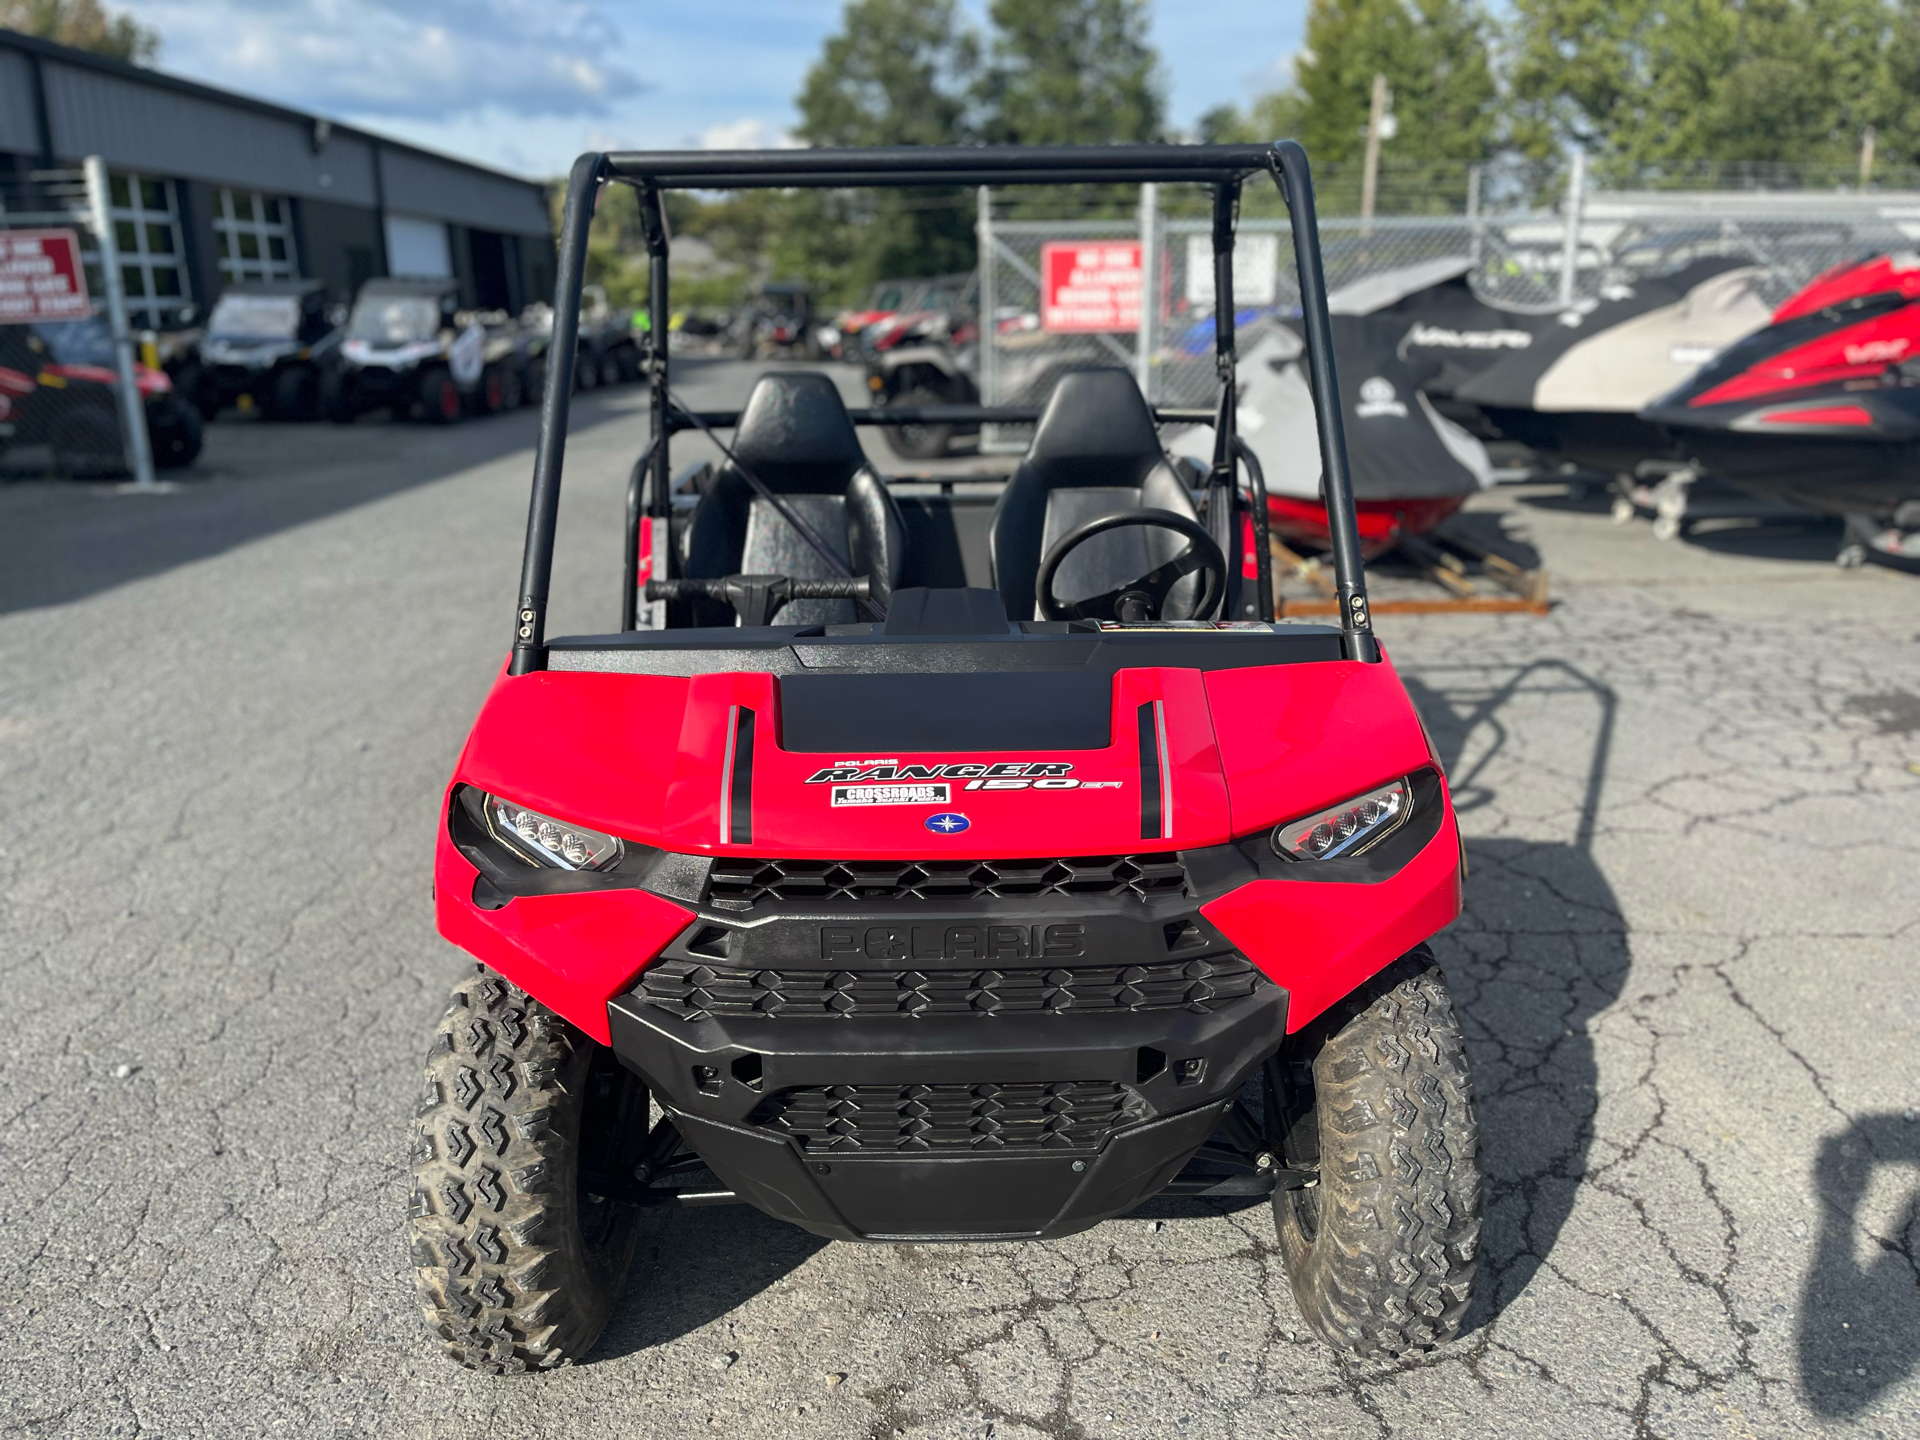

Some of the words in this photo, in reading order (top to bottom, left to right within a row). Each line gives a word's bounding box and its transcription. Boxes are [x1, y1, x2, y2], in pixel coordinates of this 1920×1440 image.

[834, 759, 899, 767] POLARIS
[804, 763, 1074, 783] RANGER
[964, 779, 1081, 791] 150
[846, 787, 935, 799] CROSSROADS
[820, 925, 1085, 960] POLARIS
